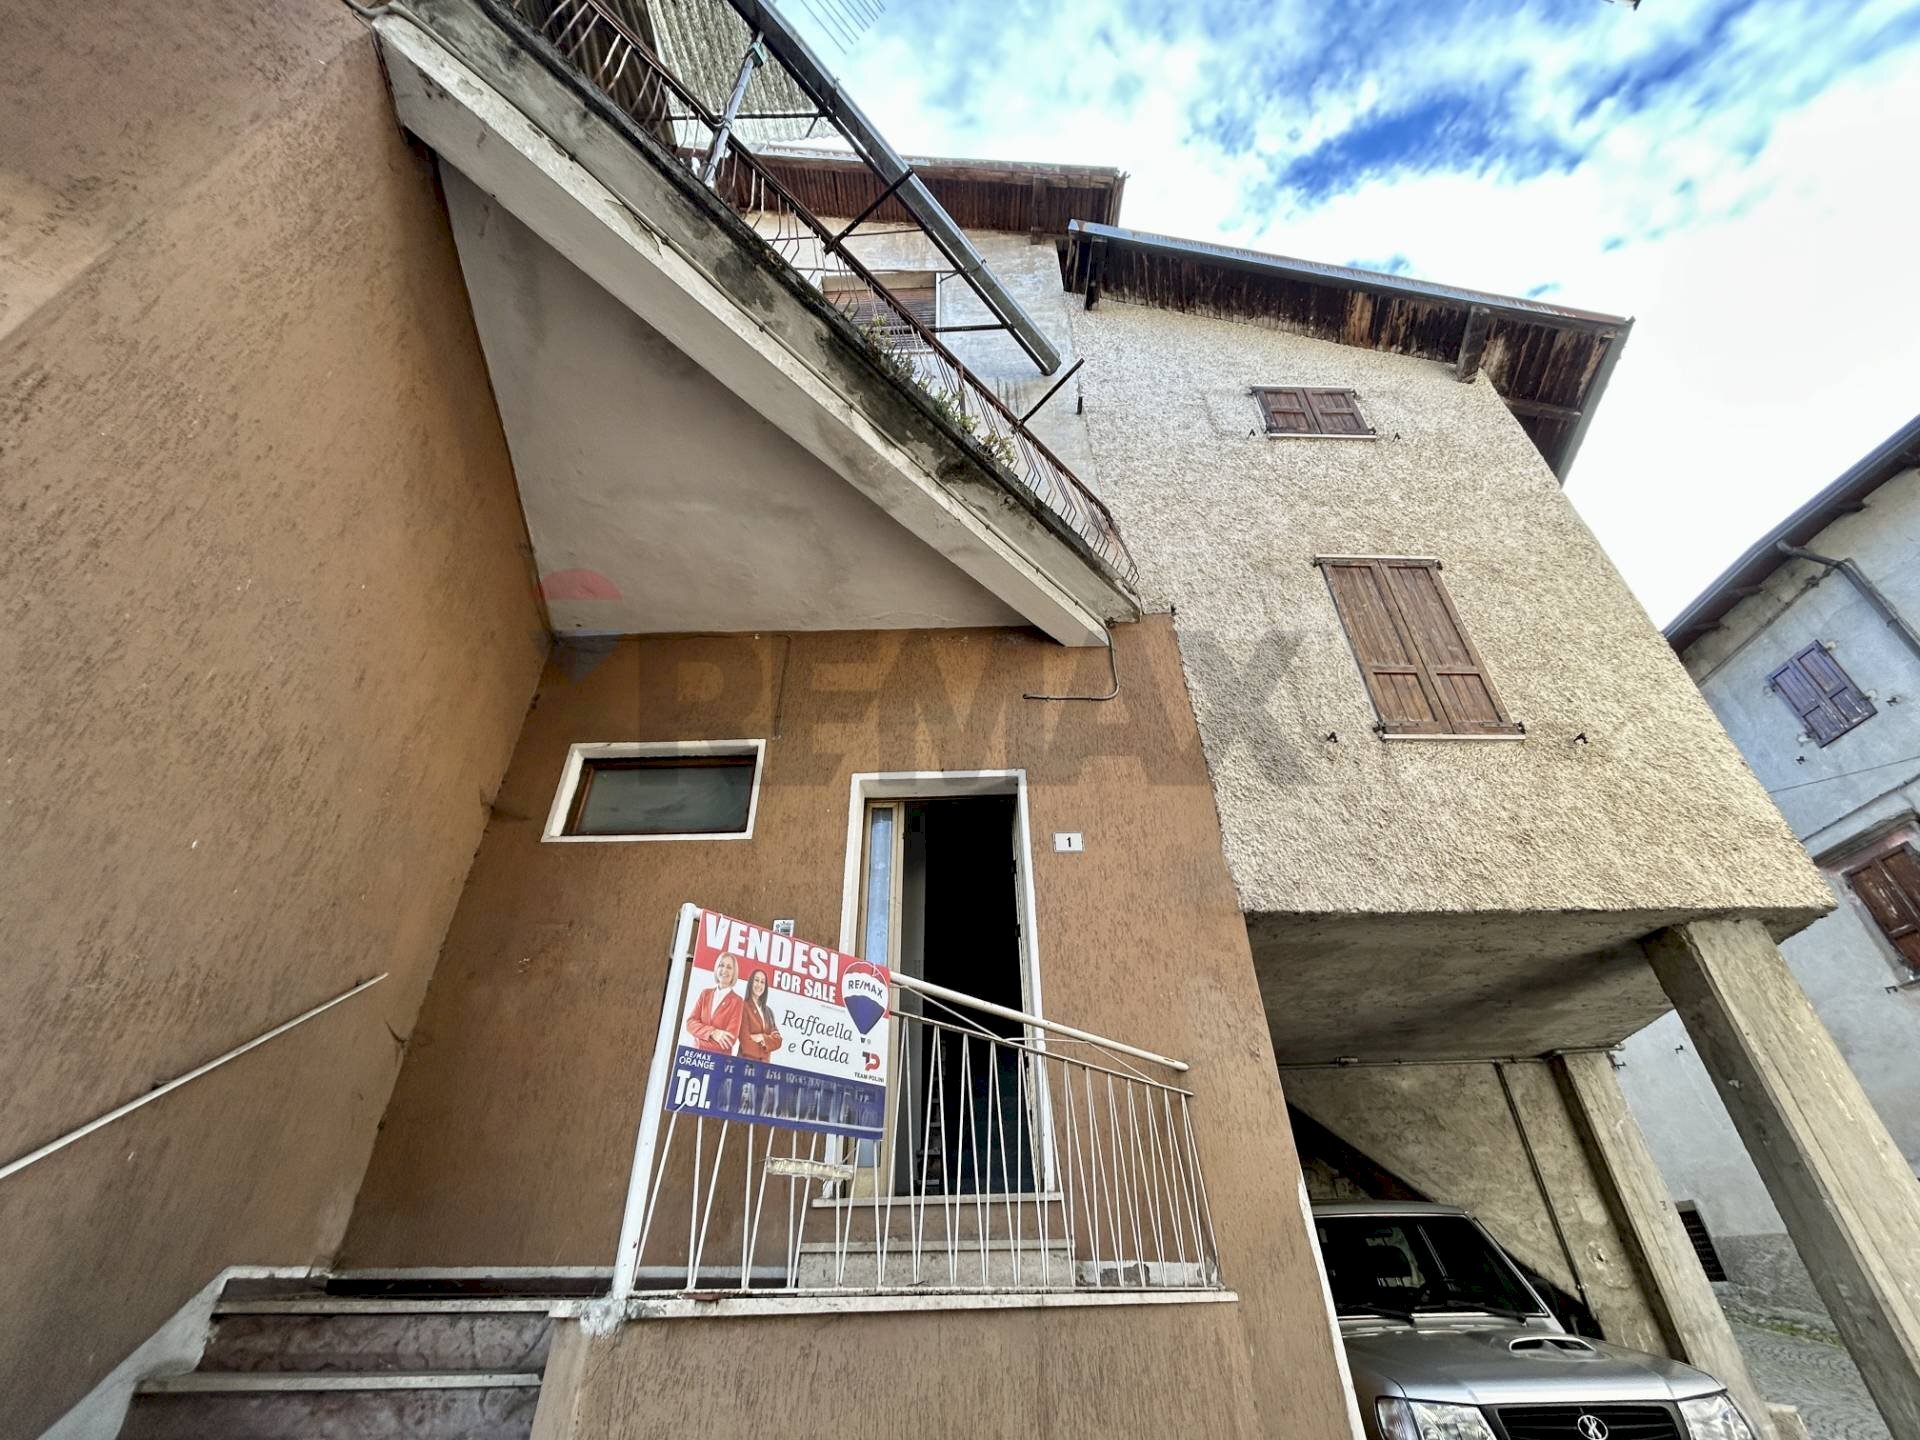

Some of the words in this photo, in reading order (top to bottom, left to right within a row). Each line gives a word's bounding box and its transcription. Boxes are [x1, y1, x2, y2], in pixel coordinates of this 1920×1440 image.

[1066, 836, 1072, 848] 1
[705, 913, 840, 984] VENDESI
[773, 970, 801, 993] FOR
[804, 978, 836, 1003] SALE
[848, 978, 884, 999] RE/MAX
[781, 1010, 853, 1042] Raffaella
[679, 1056, 715, 1071] ORANGE
[684, 1050, 712, 1061] RE/MAX
[788, 1042, 797, 1053] e
[801, 1039, 850, 1065] Giada
[674, 1069, 711, 1110] Tel.
